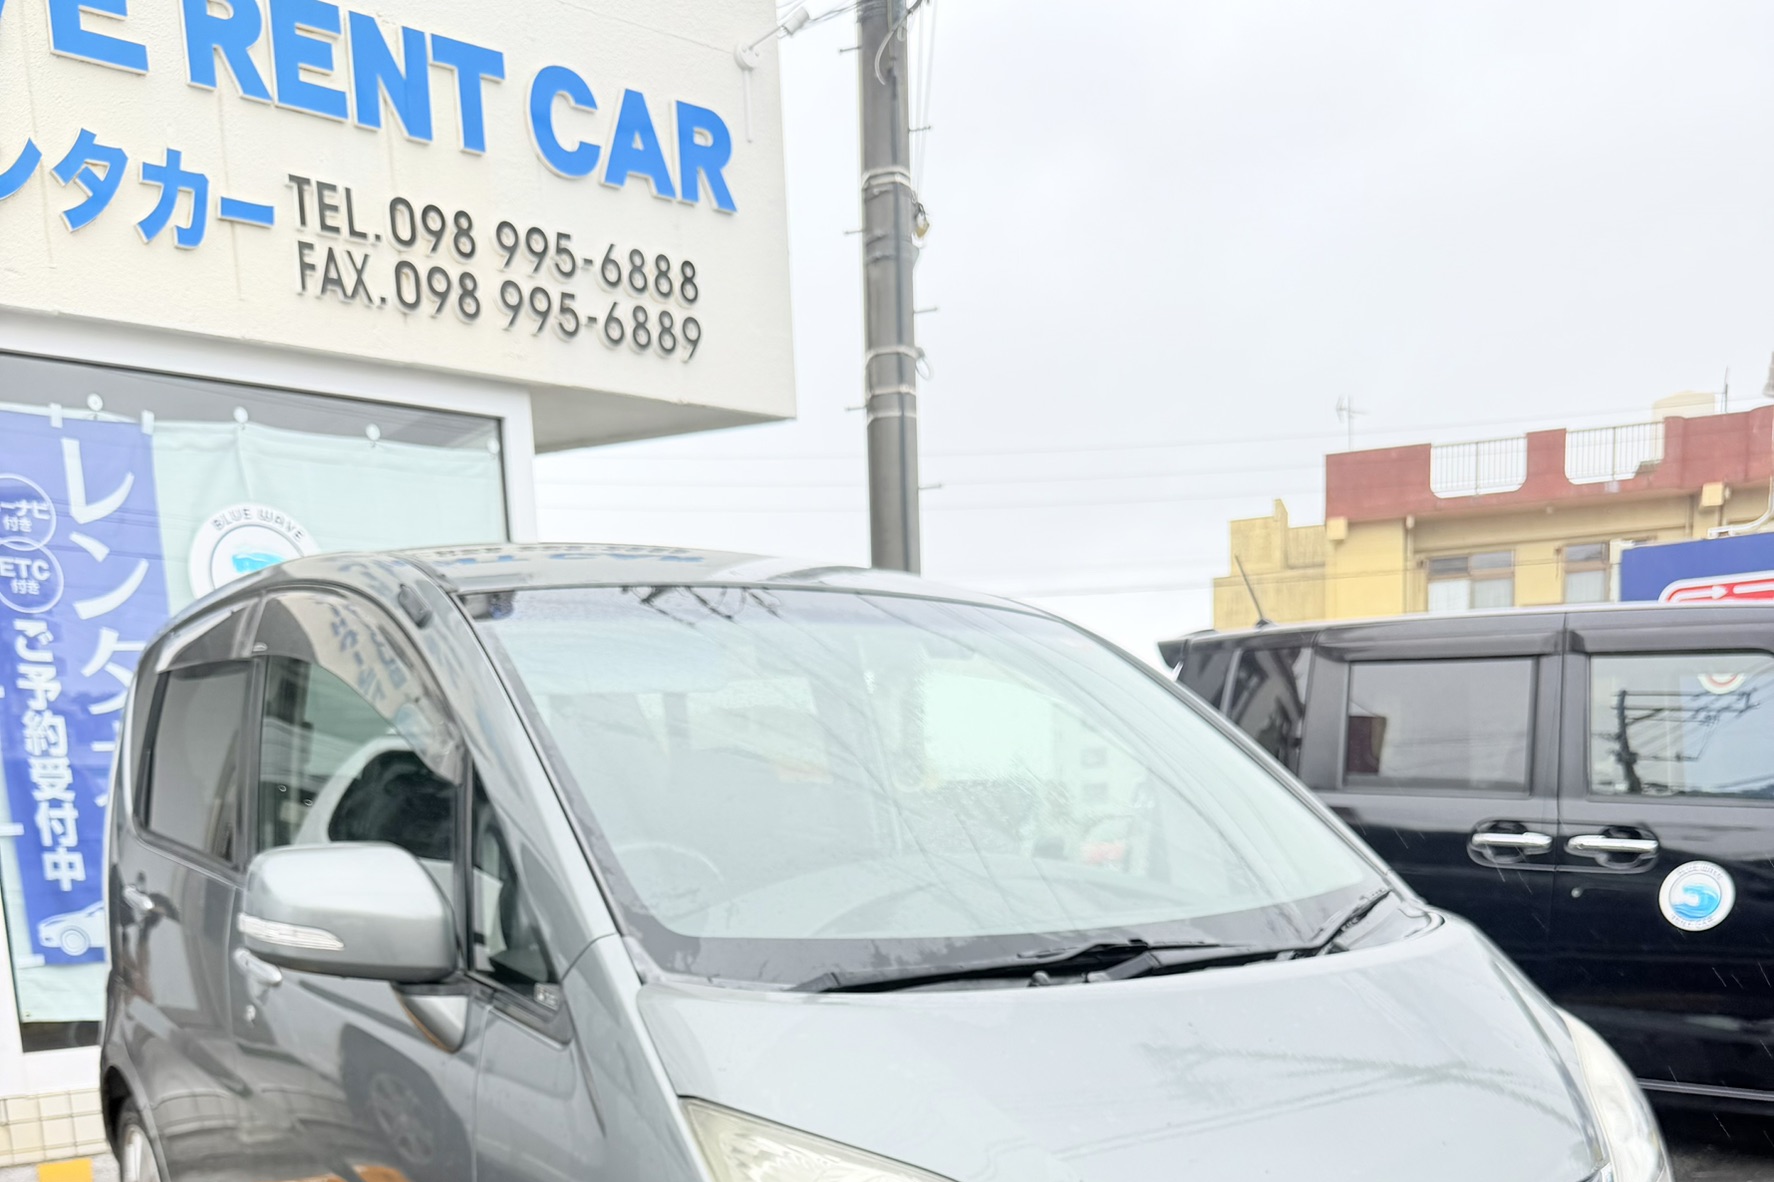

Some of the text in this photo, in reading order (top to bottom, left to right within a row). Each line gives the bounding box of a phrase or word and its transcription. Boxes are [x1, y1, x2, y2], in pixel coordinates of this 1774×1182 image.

[182, 0, 506, 153] RENT
[529, 65, 737, 212] CAR
[495, 220, 699, 305] 995-6888
[500, 279, 702, 360] 995-6889
[3, 515, 33, 533] 付き
[212, 507, 252, 531] BLUE
[0, 557, 51, 581] ETC
[10, 578, 41, 595] 付き
[12, 618, 87, 892] ご予約受付中
